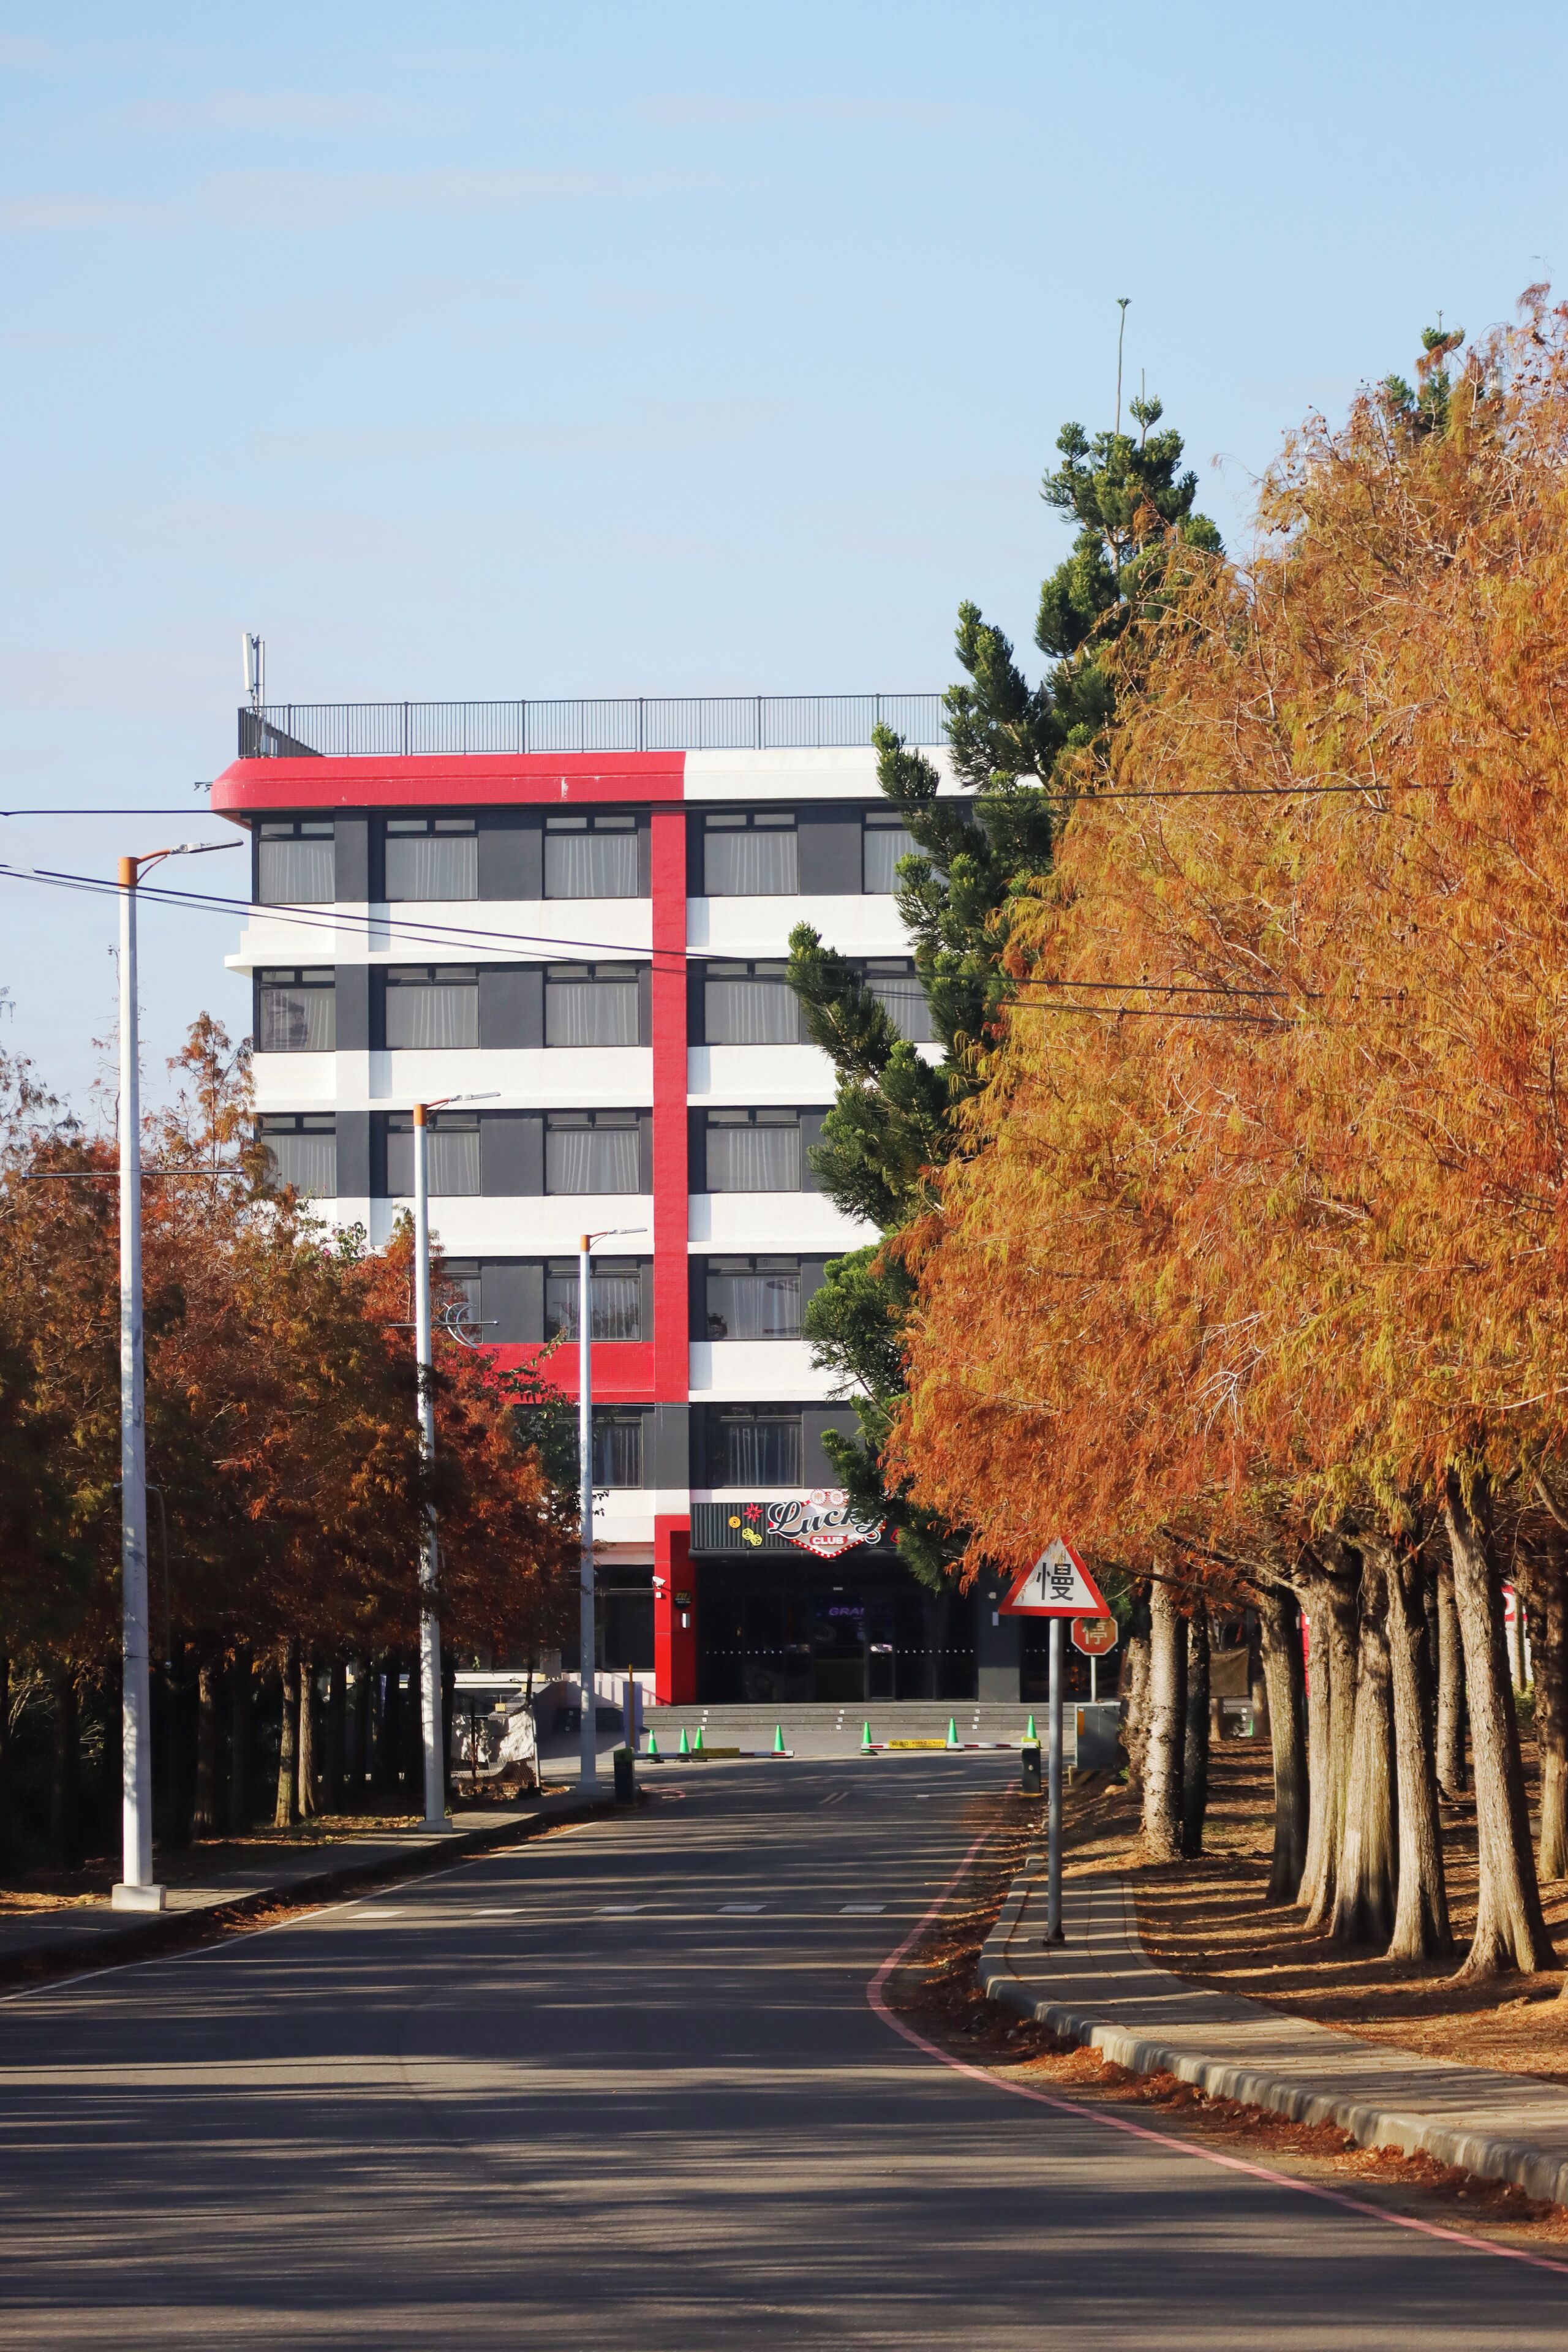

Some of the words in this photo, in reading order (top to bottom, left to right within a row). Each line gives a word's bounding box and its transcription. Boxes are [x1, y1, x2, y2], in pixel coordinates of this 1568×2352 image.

[812, 1536, 844, 1545] CLUB
[1036, 1562, 1074, 1601] 慢
[1082, 1622, 1107, 1645] 停
